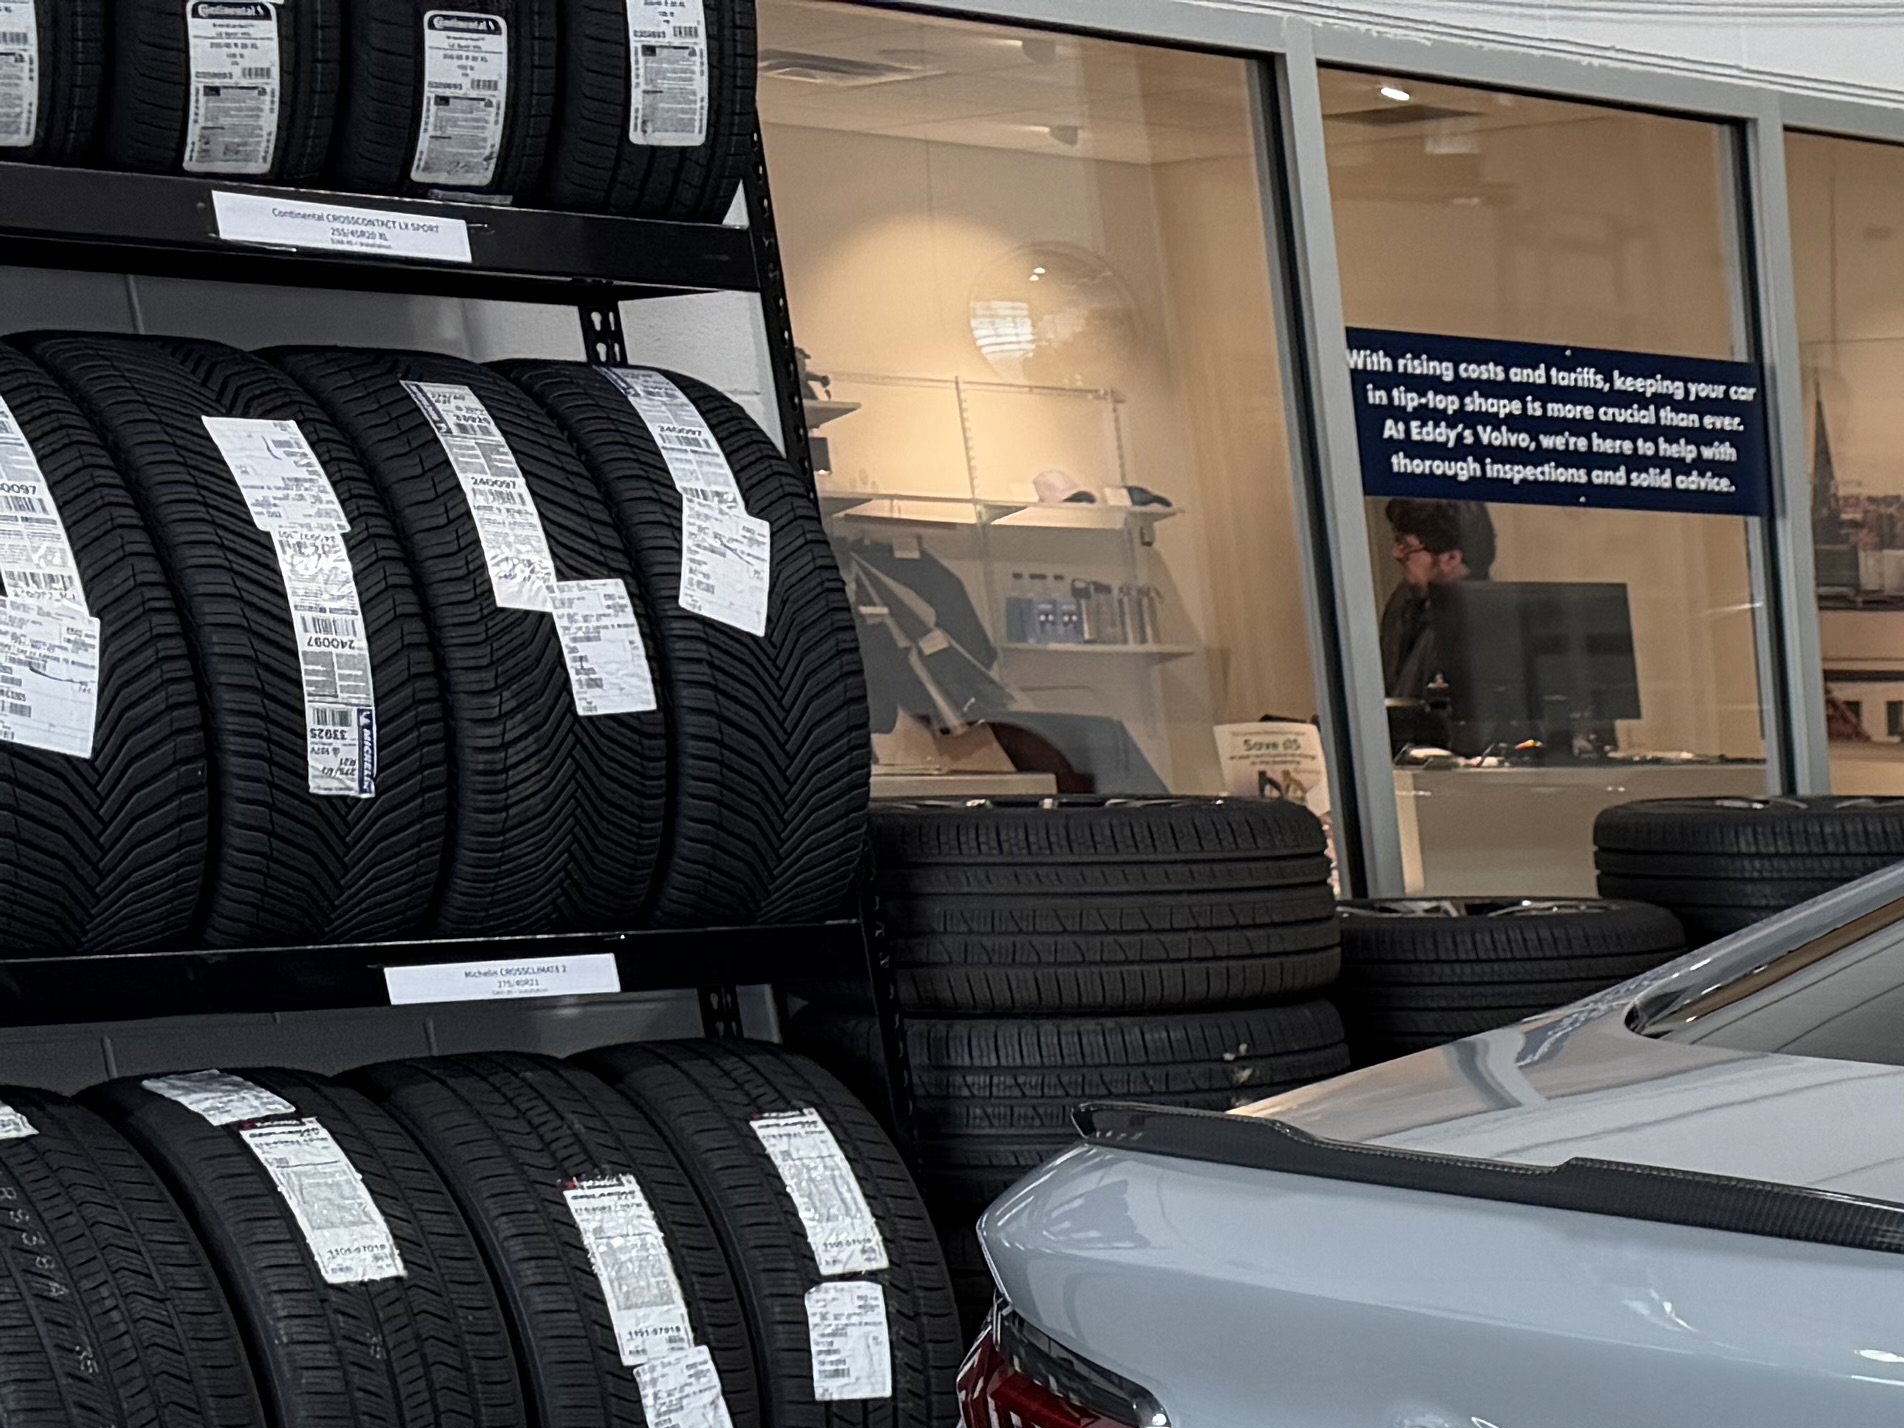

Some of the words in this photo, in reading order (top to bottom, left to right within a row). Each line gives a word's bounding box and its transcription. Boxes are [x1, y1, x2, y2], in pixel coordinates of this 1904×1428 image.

[272, 208, 324, 221] Continental
[326, 213, 396, 230] CROSSCONTACT
[411, 222, 439, 234] SPORT
[1346, 349, 1393, 372] With
[1397, 353, 1454, 382] rising
[1458, 361, 1506, 381] costs
[1509, 363, 1546, 384] and
[1551, 367, 1610, 392] tariffs,
[1613, 369, 1685, 400] keeping
[1687, 382, 1727, 401] your
[1729, 385, 1757, 401] car
[1366, 383, 1388, 405] in
[1392, 385, 1459, 415] tip-top
[1464, 390, 1522, 418] shape
[1526, 395, 1542, 417] is
[1547, 402, 1594, 420] more
[1598, 403, 1656, 424] crucial
[1659, 405, 1700, 428] than
[1703, 414, 1745, 431] ever.
[1382, 418, 1406, 440] At
[1410, 420, 1474, 448] Eddy's
[1477, 424, 1536, 452] Volvo,
[1539, 431, 1588, 452] we're
[1591, 431, 1634, 455] here
[1636, 437, 1655, 456] to
[1658, 436, 1698, 463] help
[1700, 441, 1738, 462] with
[0, 482, 37, 496] 0097
[1391, 451, 1482, 482] thorough
[1485, 457, 1588, 485] inspections
[1591, 465, 1627, 486] and
[1630, 467, 1673, 489] solid
[1675, 470, 1736, 492] advice.
[306, 636, 355, 650] 240097
